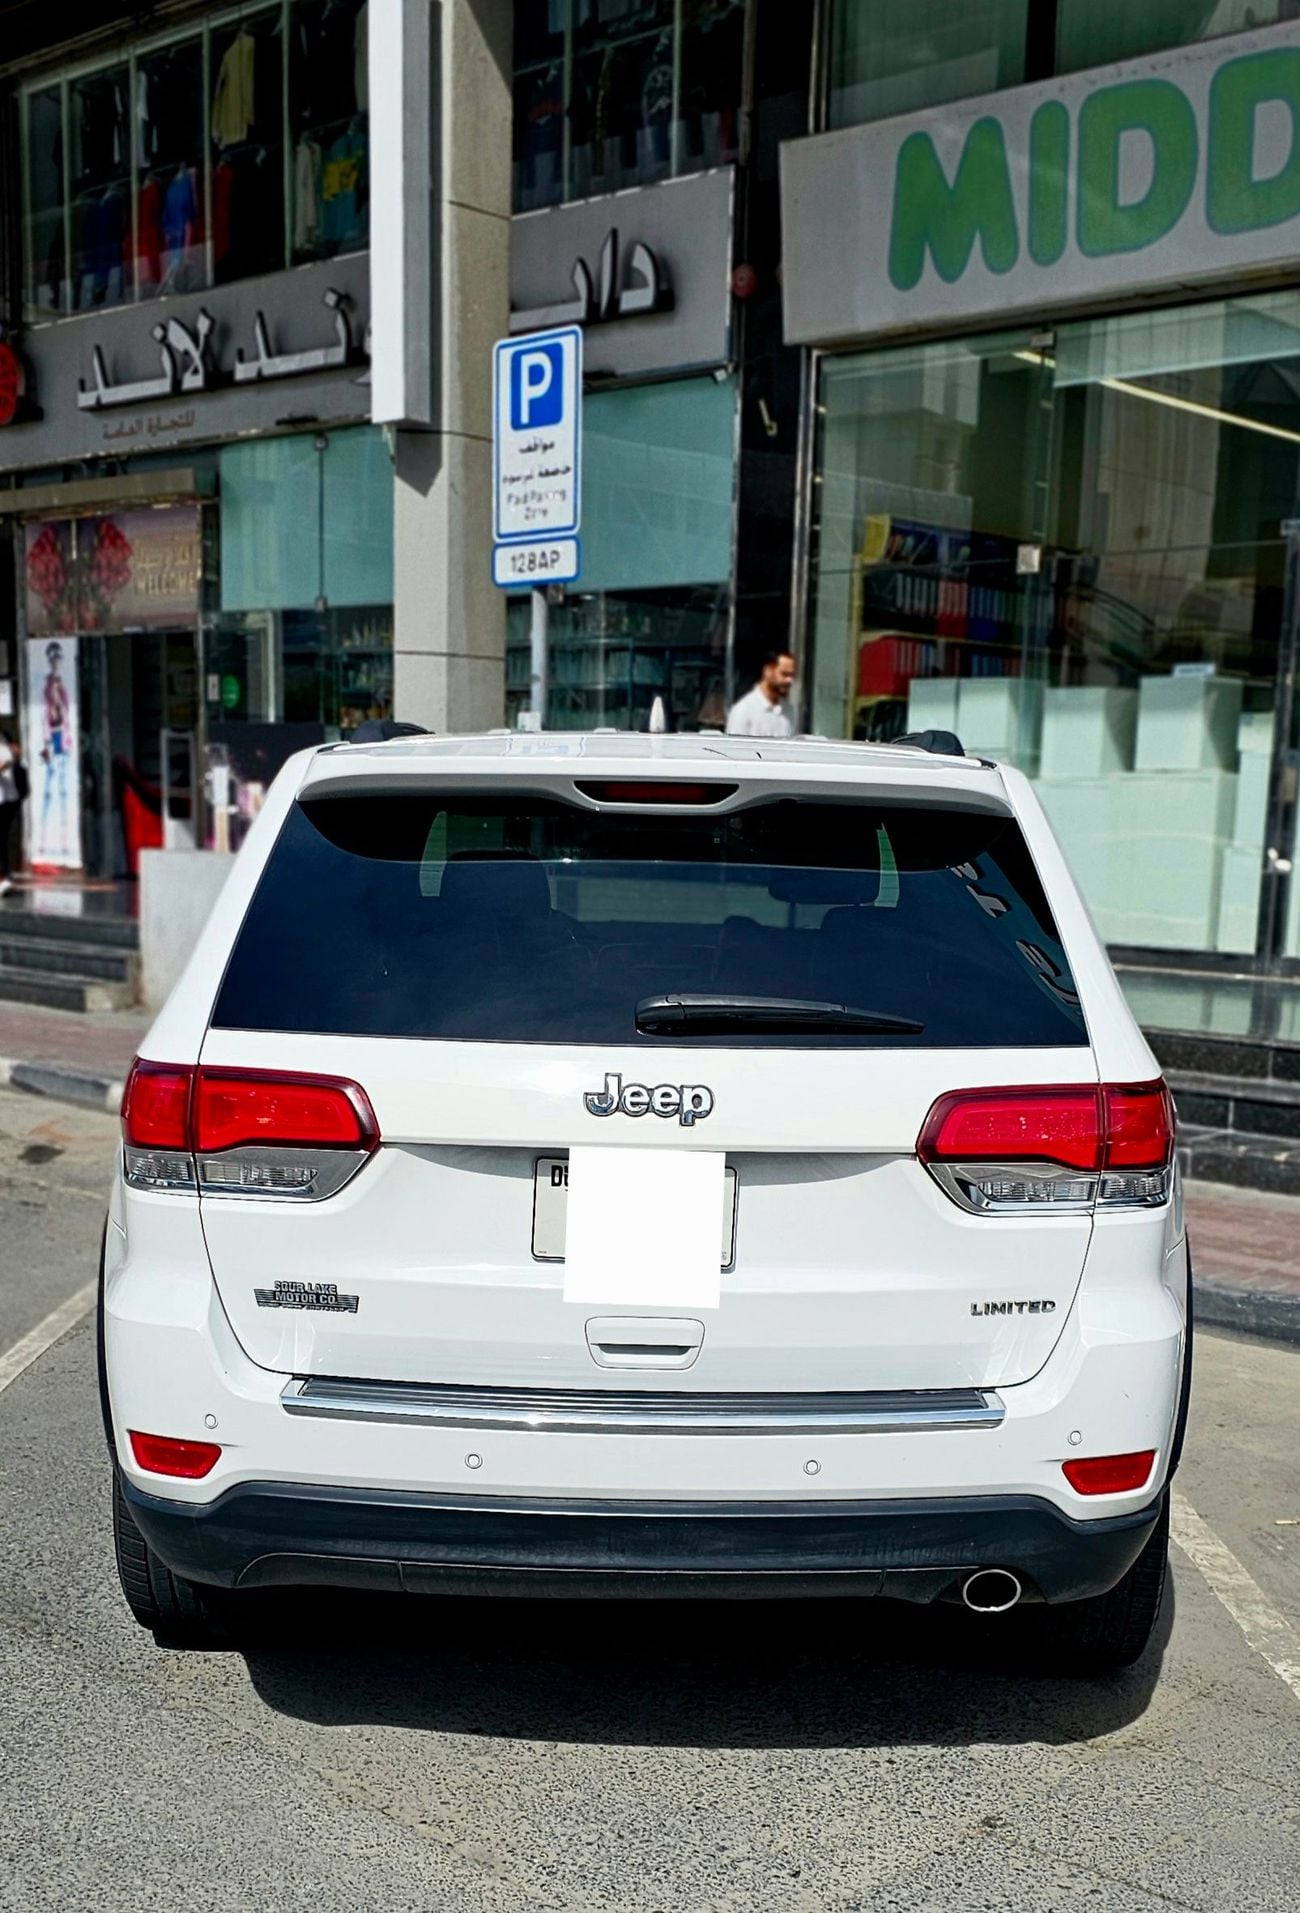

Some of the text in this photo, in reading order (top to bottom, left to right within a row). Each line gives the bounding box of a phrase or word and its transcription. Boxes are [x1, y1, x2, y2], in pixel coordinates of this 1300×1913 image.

[520, 351, 553, 425] P
[510, 549, 561, 573] 128AP
[583, 1072, 715, 1126] Jeep
[274, 1291, 317, 1304] MOTOR
[306, 1283, 338, 1295] LAKE
[970, 1299, 1056, 1316] LIMITED
